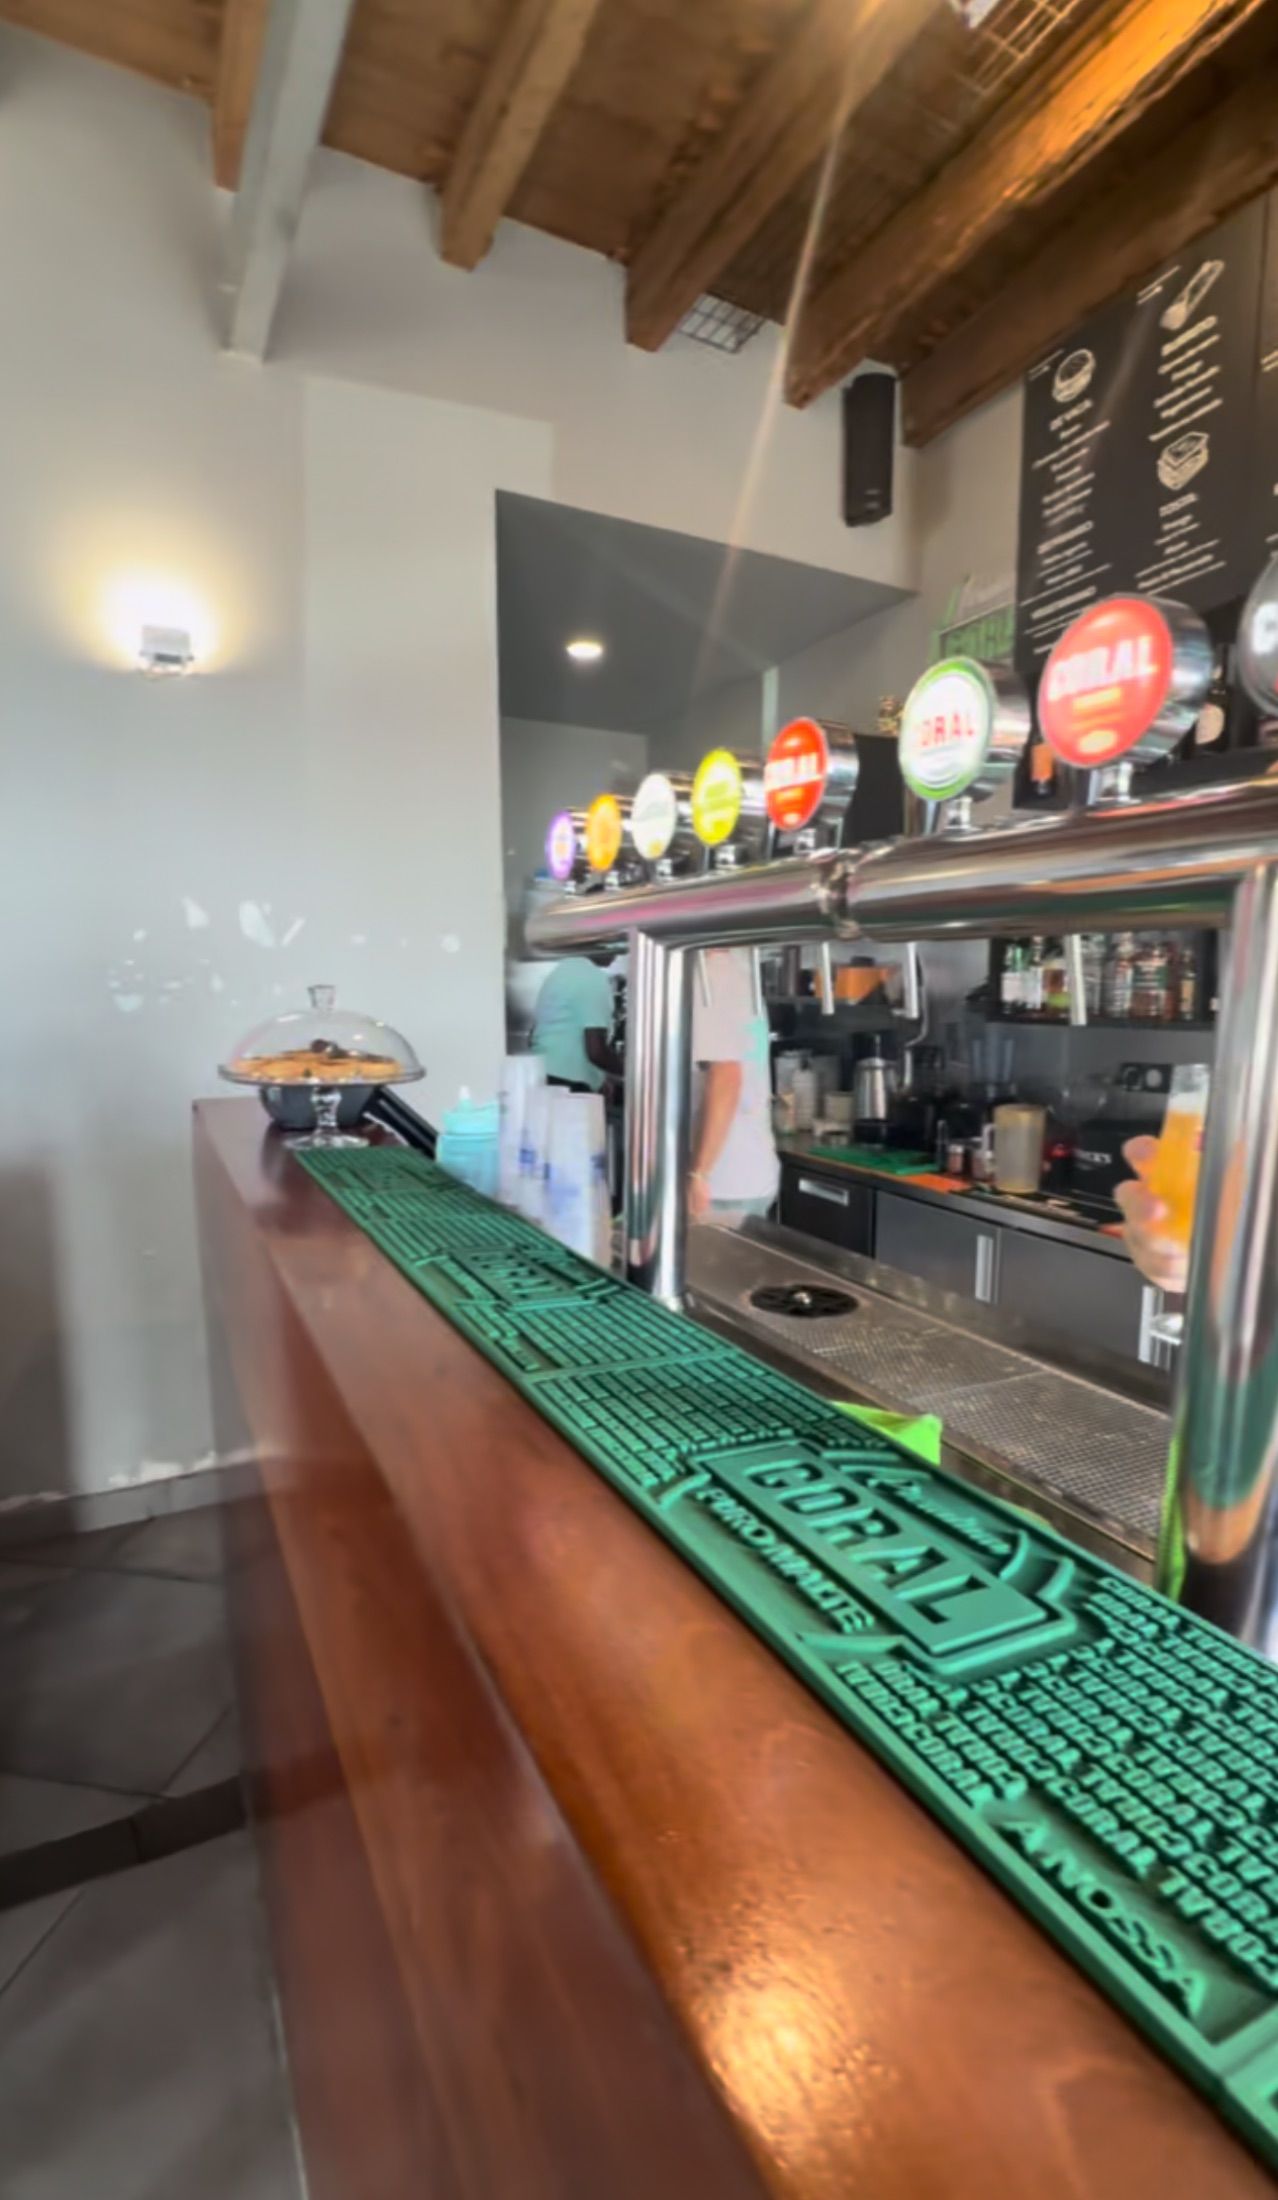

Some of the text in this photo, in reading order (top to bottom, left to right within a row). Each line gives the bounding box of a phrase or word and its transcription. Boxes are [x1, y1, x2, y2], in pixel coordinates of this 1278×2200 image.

[696, 1487, 876, 1634] PURO MALTE
[741, 1458, 989, 1625] CORAL
[1000, 1817, 1209, 2015] A NOSSA
